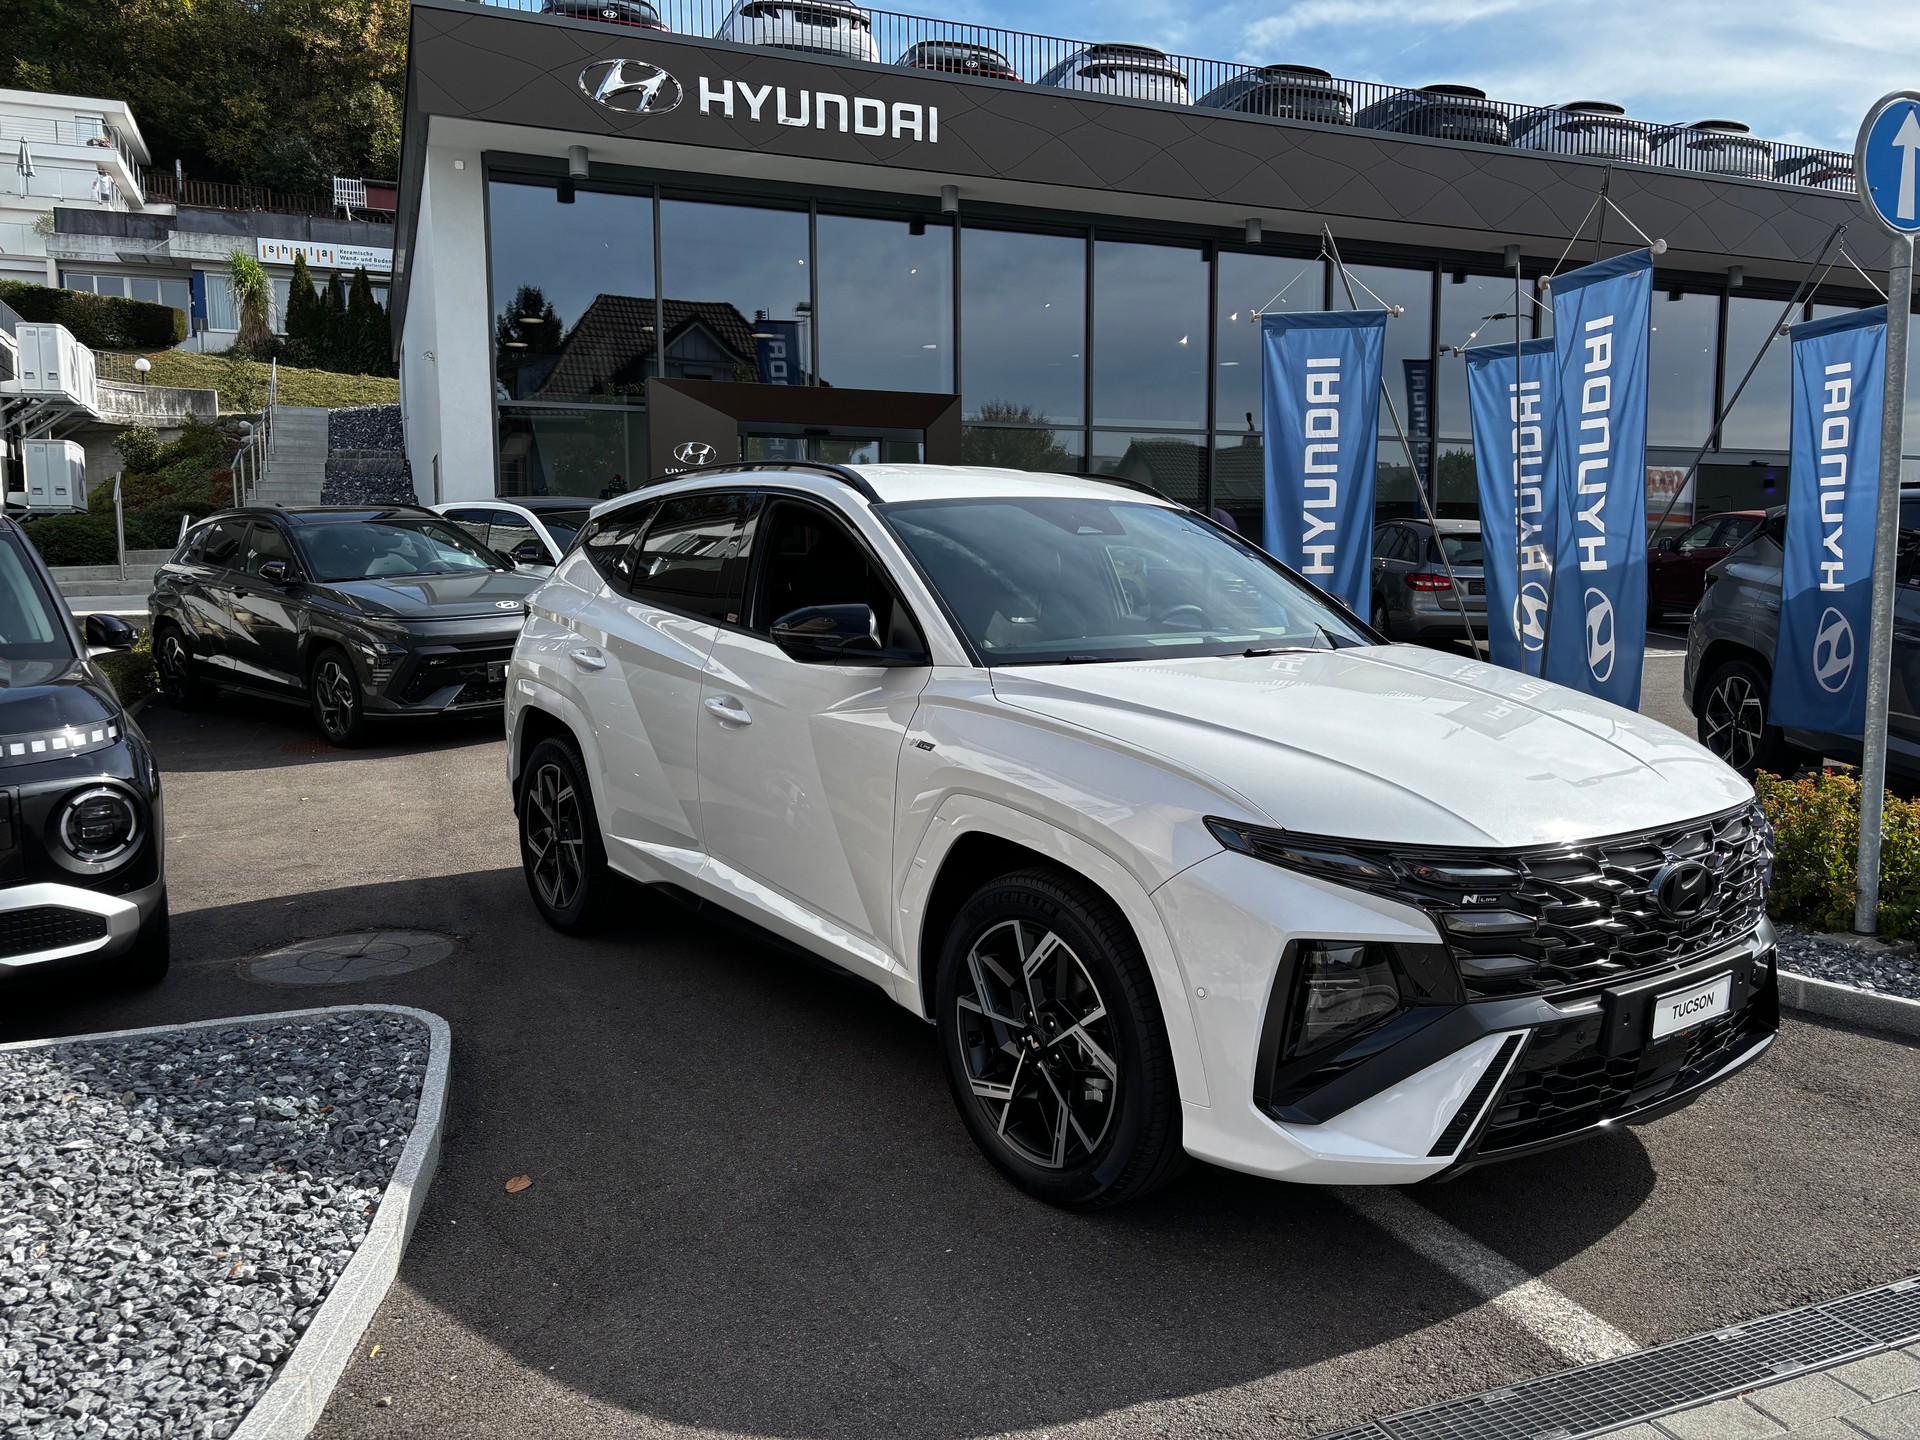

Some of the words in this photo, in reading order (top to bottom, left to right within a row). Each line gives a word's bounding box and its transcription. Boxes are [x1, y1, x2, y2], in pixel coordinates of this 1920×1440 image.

[698, 76, 938, 143] HYUNDAI
[268, 244, 328, 257] shala
[1301, 357, 1341, 575] HYUNDAI
[1509, 381, 1547, 571] HYUNDAI
[1672, 991, 1715, 1020] TUCSON
